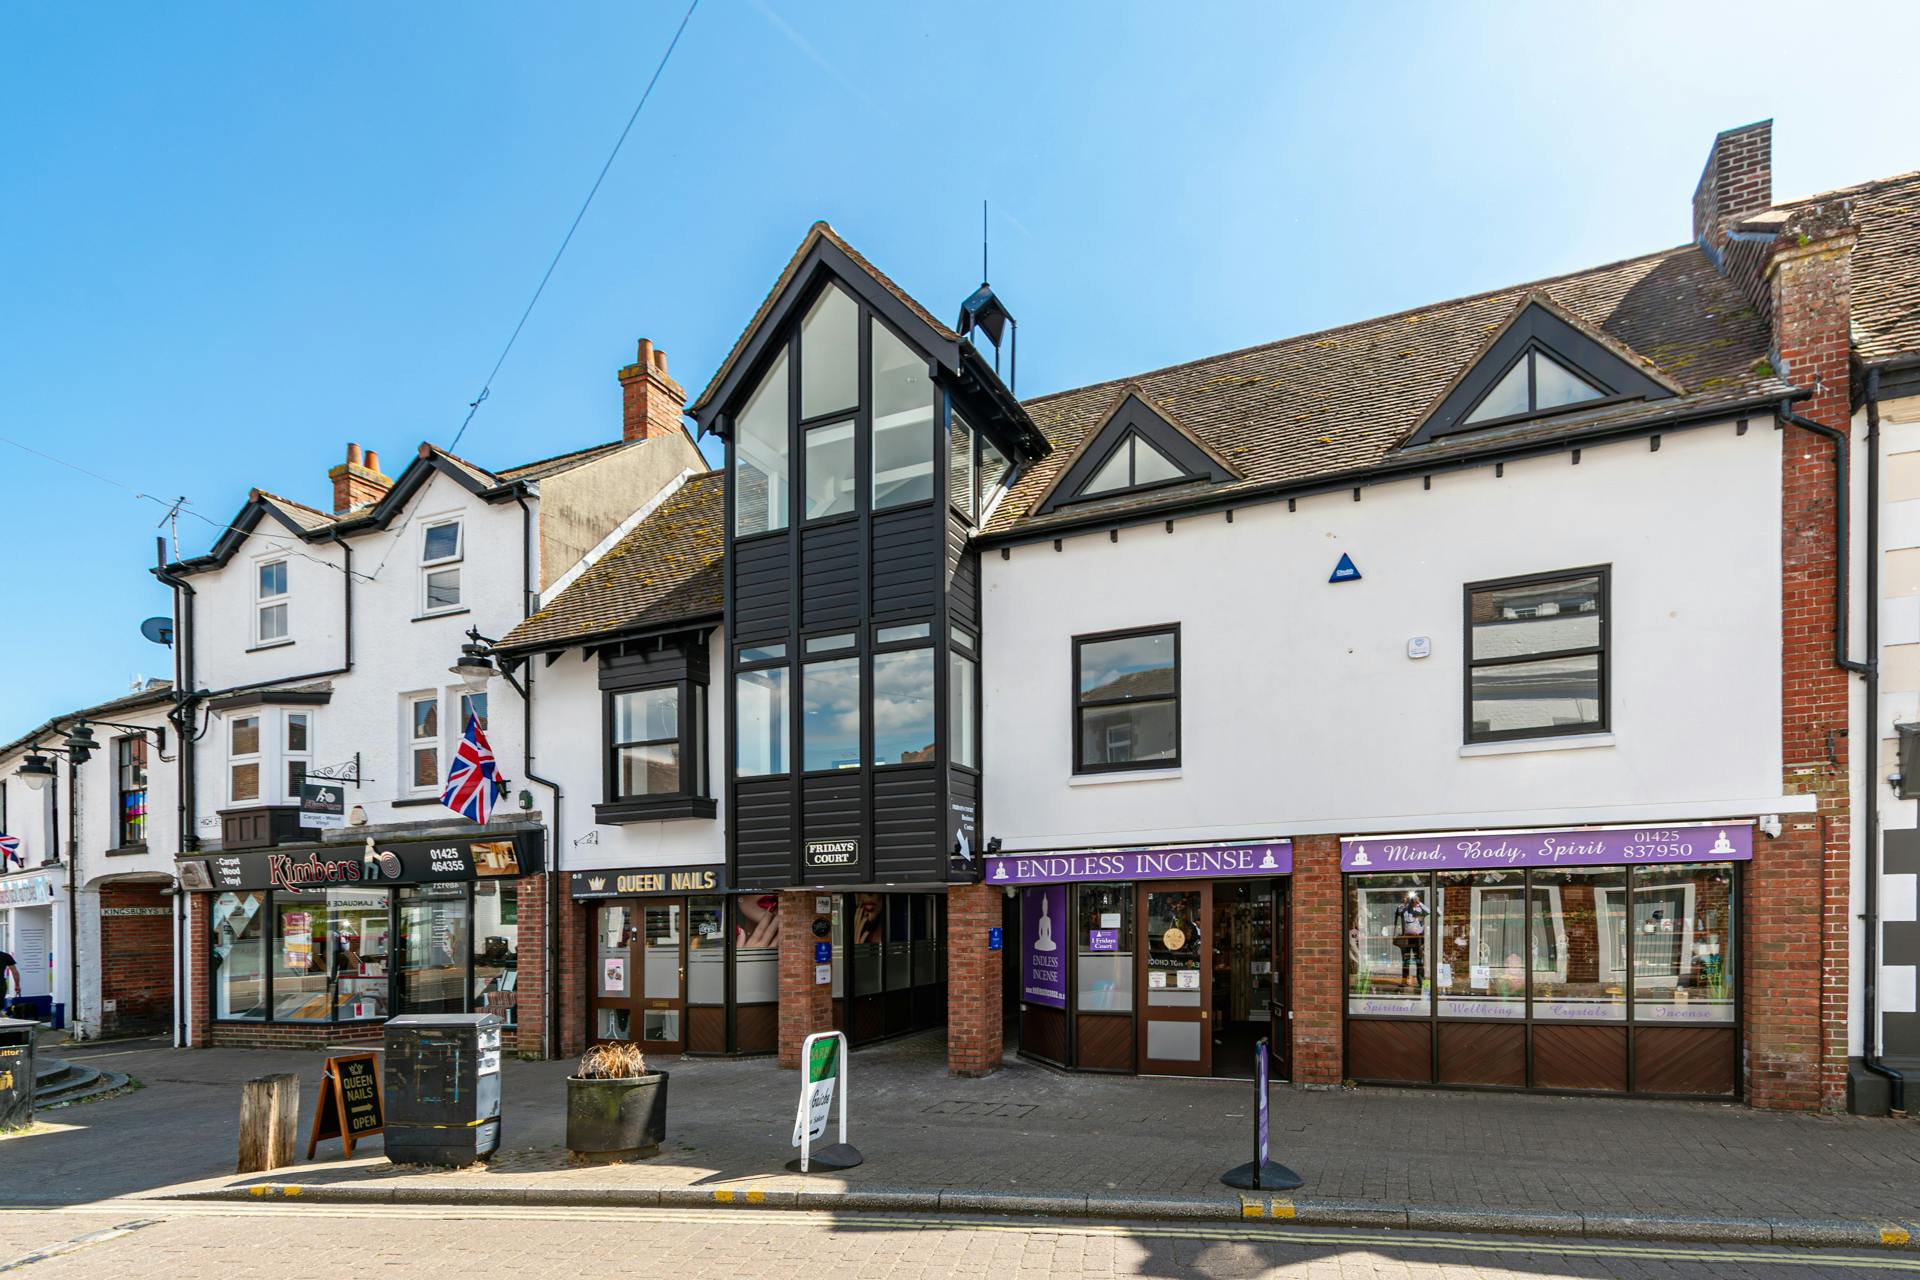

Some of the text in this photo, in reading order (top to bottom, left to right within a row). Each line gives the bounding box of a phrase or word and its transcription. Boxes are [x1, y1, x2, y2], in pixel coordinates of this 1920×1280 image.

[1634, 830, 1680, 843] 01425
[430, 848, 459, 860] 01425
[809, 843, 854, 854] FRIDAYS
[1384, 837, 1607, 863] Mind, Body, Spirit
[1623, 843, 1694, 858] 837950
[814, 854, 849, 864] COURT
[1016, 850, 1253, 878] ENDLESS INCENSE
[431, 860, 465, 872] 464355
[268, 853, 360, 894] Kimbers
[617, 871, 716, 893] QUEEN NAILS
[1096, 937, 1116, 945] Fridays
[1032, 955, 1058, 968] ENDLESS
[1032, 969, 1058, 982] INCENSE
[1363, 1001, 1416, 1014] Spiritual
[1449, 1003, 1513, 1016] Wellbeing
[1550, 1005, 1608, 1018] Crystals
[1655, 1007, 1712, 1019] Incense
[344, 1075, 373, 1089] QUEEN
[347, 1088, 374, 1102] NAILS
[353, 1115, 376, 1130] OPEN
